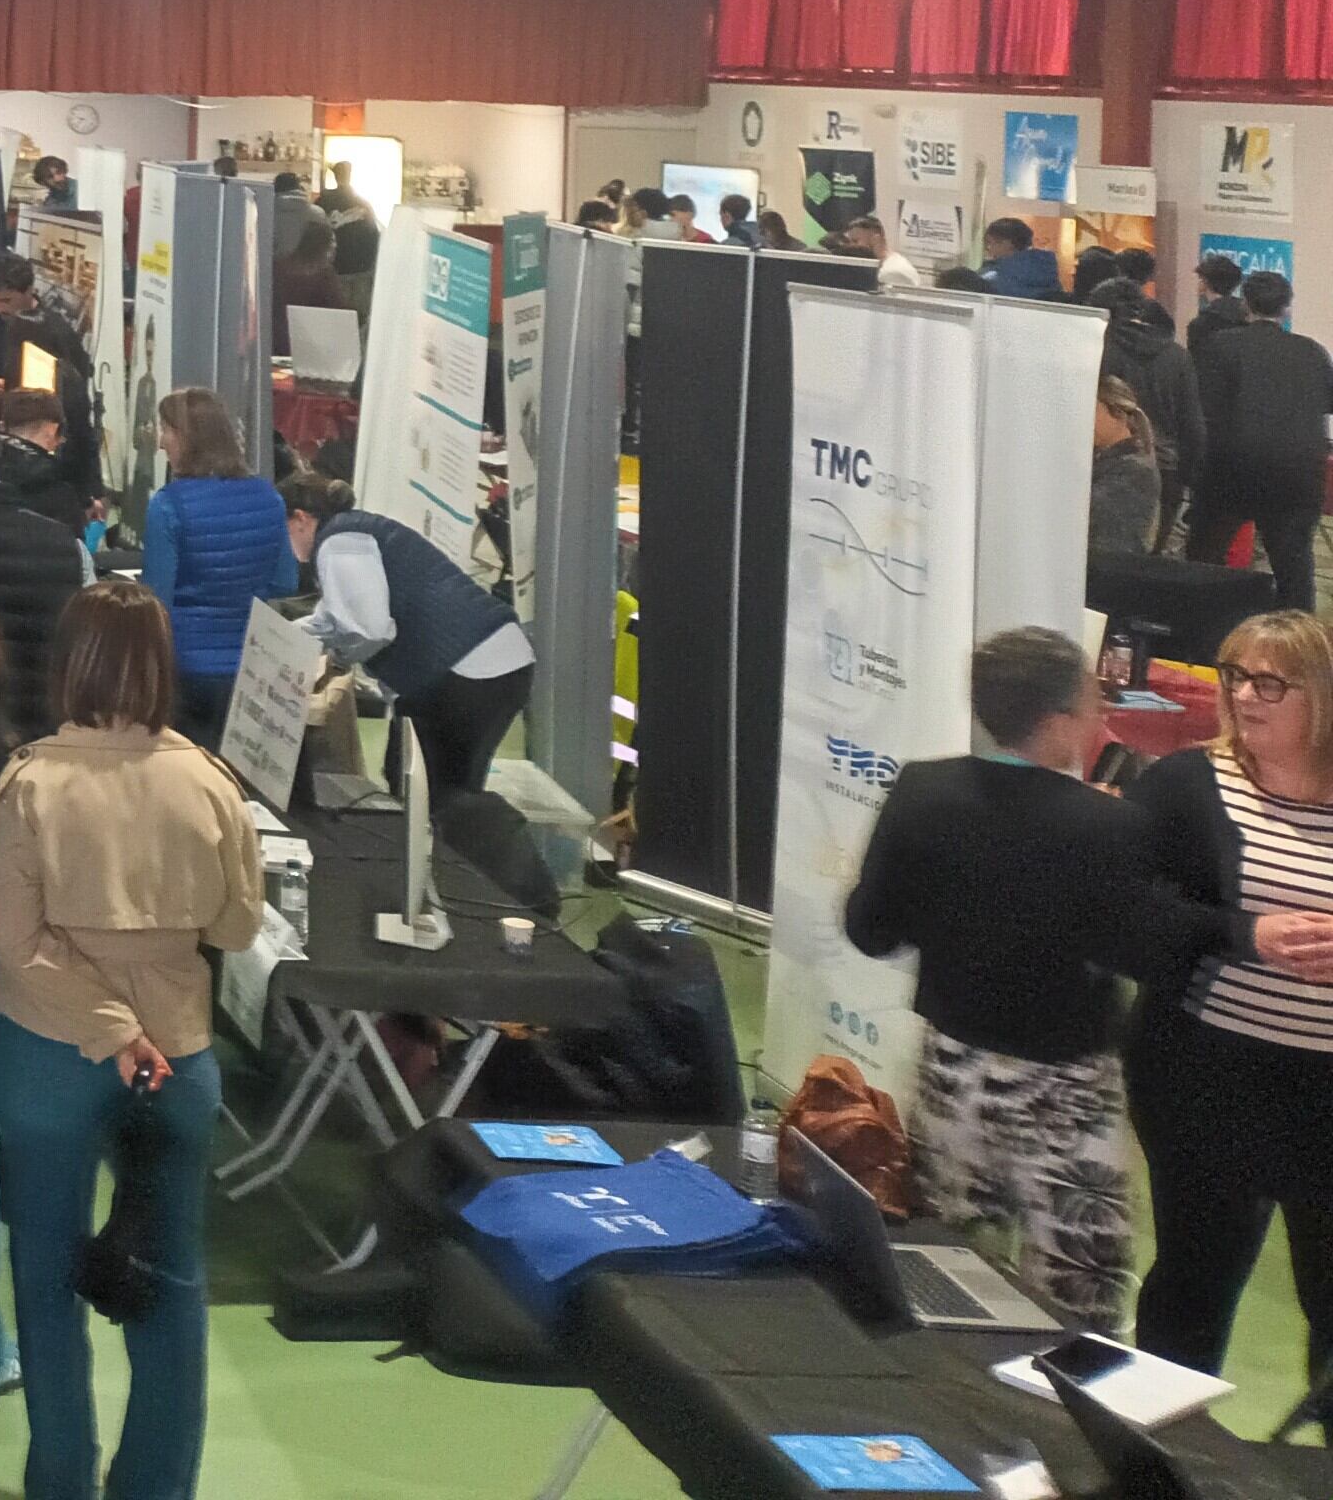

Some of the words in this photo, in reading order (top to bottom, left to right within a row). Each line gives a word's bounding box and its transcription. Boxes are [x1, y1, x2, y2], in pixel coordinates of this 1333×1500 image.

[919, 141, 957, 168] SIBE
[810, 438, 873, 488] TMC
[876, 471, 935, 510] GRUPO
